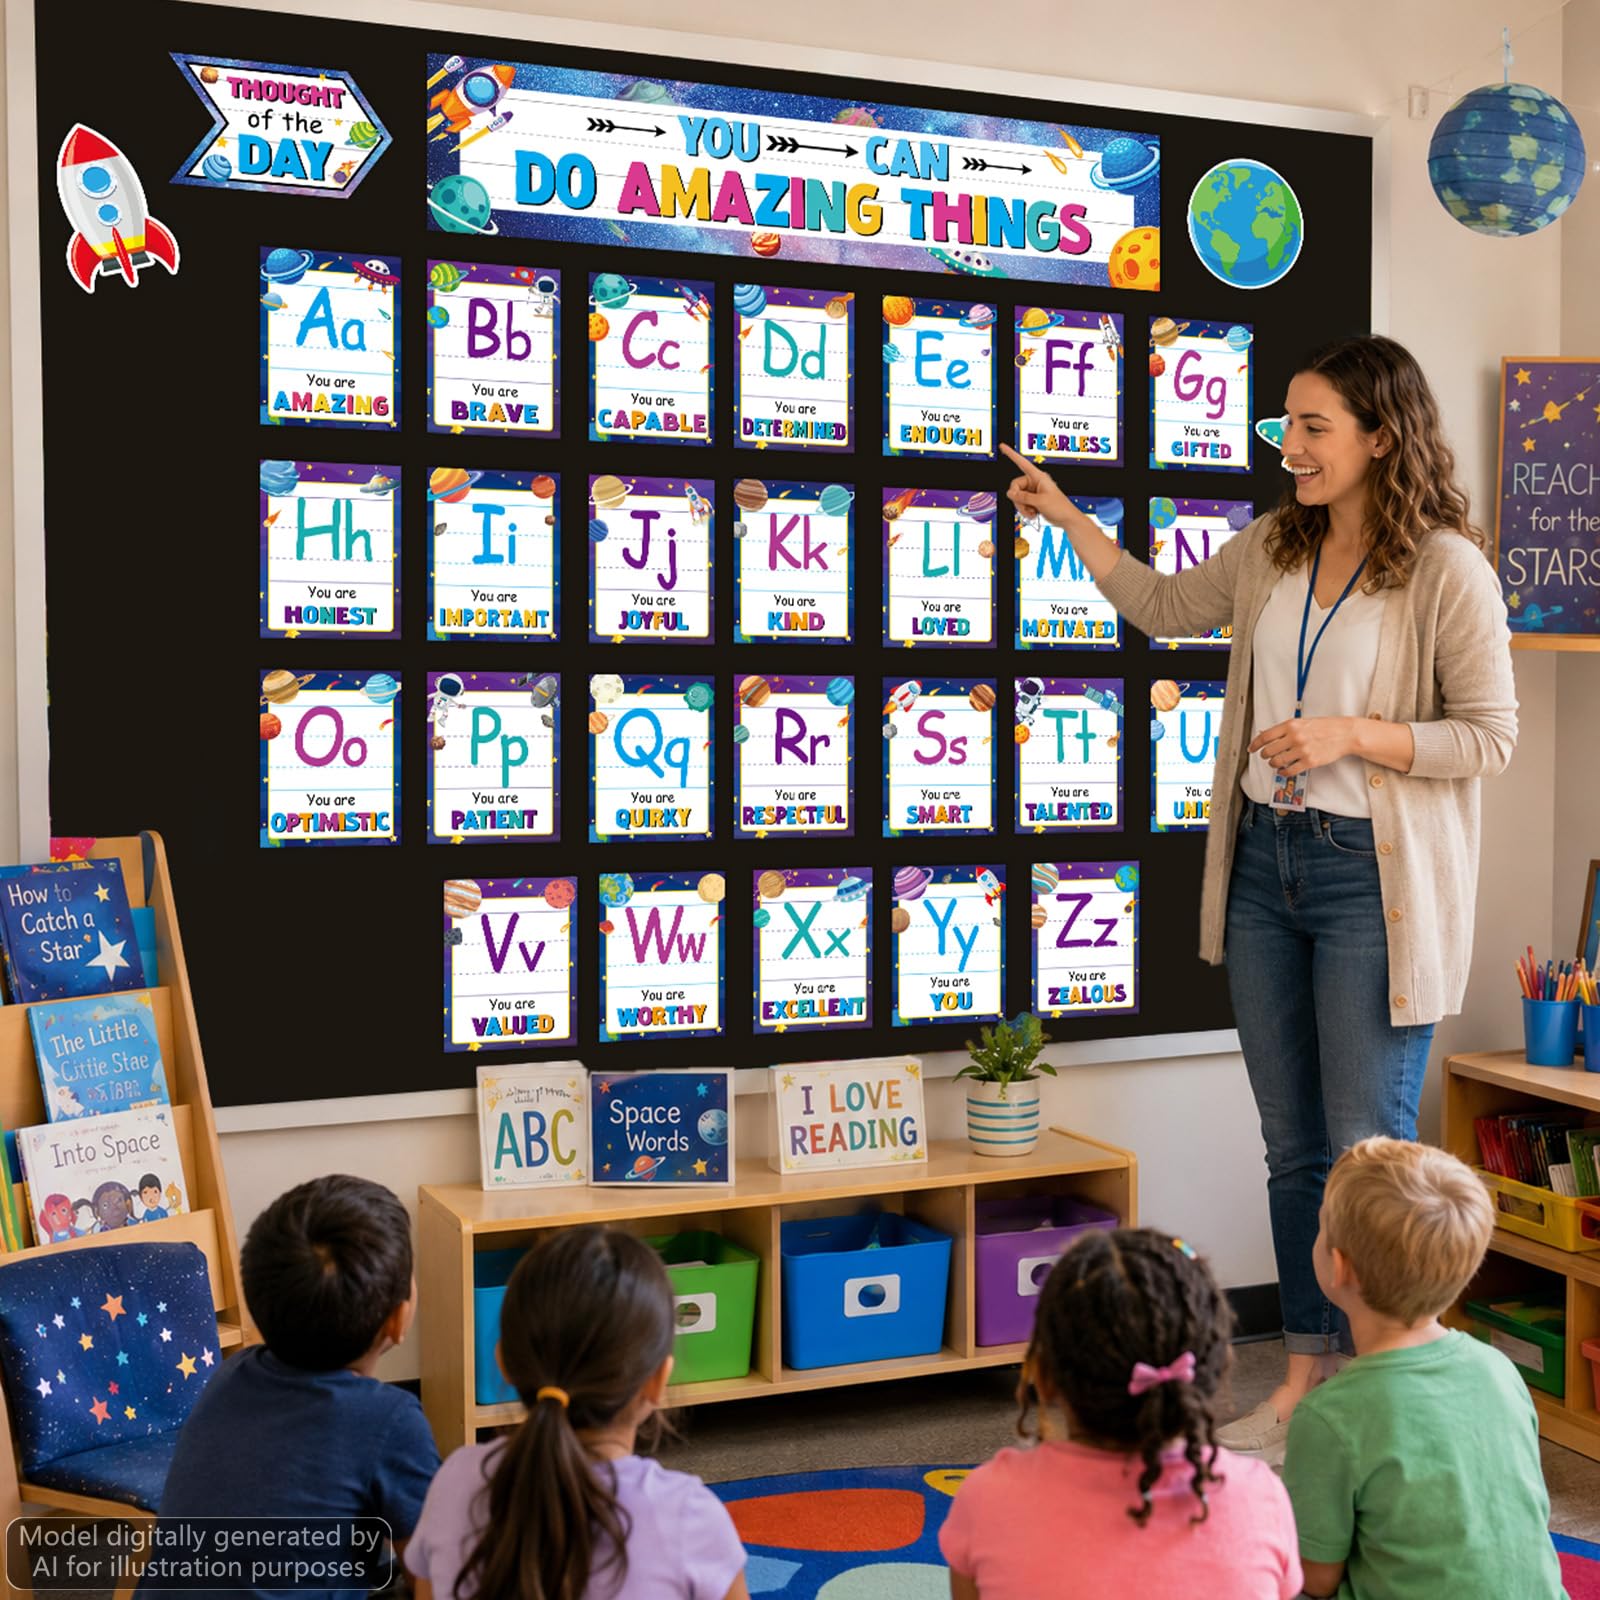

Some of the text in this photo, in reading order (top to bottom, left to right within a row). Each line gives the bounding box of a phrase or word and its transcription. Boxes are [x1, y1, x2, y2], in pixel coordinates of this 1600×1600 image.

[226, 76, 346, 109] THOUGHT
[247, 108, 323, 134] of the
[238, 133, 333, 181] DAY
[677, 114, 951, 181] YOU CAN
[514, 149, 1093, 256] DO AMAZING THINGS
[295, 285, 367, 353] Aa
[467, 298, 531, 360] Bb
[622, 311, 680, 369] Cc
[763, 319, 827, 380] Dd
[914, 329, 972, 390] Ee
[1045, 339, 1094, 396] Ff
[306, 373, 356, 389] You are
[471, 383, 519, 398] You are
[1174, 350, 1227, 420] Gg
[272, 390, 389, 417] AMAZING
[630, 392, 675, 407] You are
[774, 401, 817, 415] You are
[451, 400, 539, 425] BRAVE
[597, 408, 705, 433] CAPABLE
[920, 409, 961, 423] You are
[1050, 417, 1089, 431] You are
[742, 417, 846, 441] DETERMINED
[899, 423, 982, 447] ENOUGH
[1183, 425, 1220, 438] You are
[1027, 432, 1112, 454] FEARLESS
[1170, 440, 1232, 459] GIFTED
[295, 496, 373, 562] Hh
[1528, 506, 1600, 532] for the
[471, 502, 517, 566] Ii
[768, 513, 829, 570] Kk
[622, 510, 677, 590] Jj
[1036, 525, 1095, 582] M
[307, 585, 357, 599] You are
[470, 589, 518, 603] You are
[631, 593, 676, 607] You are
[773, 594, 816, 607] You are
[284, 604, 378, 626] HONEST
[439, 607, 550, 628] IMPORTANT
[921, 600, 962, 613] You are
[1050, 604, 1088, 615] You are
[618, 609, 689, 631] JOYFUL
[767, 610, 826, 631] KIND
[911, 616, 970, 636] LOVED
[1022, 619, 1116, 638] MOTIVATED
[295, 706, 367, 767] Oo
[470, 706, 529, 789] Pp
[775, 708, 830, 765] Rr
[914, 710, 968, 765] Ss
[1042, 708, 1097, 764] Tt
[612, 707, 691, 790] Qq
[306, 793, 356, 806] You are
[471, 791, 519, 804] You are
[631, 791, 676, 804] You are
[774, 789, 817, 801] You are
[920, 789, 961, 801] You are
[1050, 786, 1089, 798] You are
[270, 811, 390, 833] OPTIMISTIC
[451, 809, 538, 831] PATIENT
[615, 807, 692, 831] QUIRKY
[742, 804, 846, 825] RESPECTFUL
[905, 804, 973, 825] SMART
[1025, 801, 1113, 821] TALENTED
[7, 883, 72, 907] How to
[21, 906, 95, 935] Catch a
[781, 900, 851, 961] Xx
[1055, 893, 1117, 948] Zz
[481, 912, 545, 973] Vv
[625, 906, 706, 964] Ww
[922, 897, 980, 974] Yy
[40, 940, 83, 963] Star
[793, 982, 836, 995] You are
[930, 976, 970, 988] You are
[1068, 971, 1106, 982] You are
[488, 998, 536, 1011] You are
[641, 989, 686, 1002] You are
[929, 991, 973, 1011] YOU
[1048, 983, 1127, 1006] ZEALOUS
[616, 1003, 708, 1028] WORTHY
[762, 996, 865, 1020] EXCELLENT
[472, 1013, 555, 1037] VALUED
[49, 1019, 139, 1058] The Little
[801, 1079, 903, 1115] I LOVE
[609, 1099, 681, 1131] Space
[494, 1108, 577, 1170] ABC
[626, 1129, 689, 1152] Words
[790, 1116, 917, 1156] READING
[50, 1134, 160, 1168] Into Space
